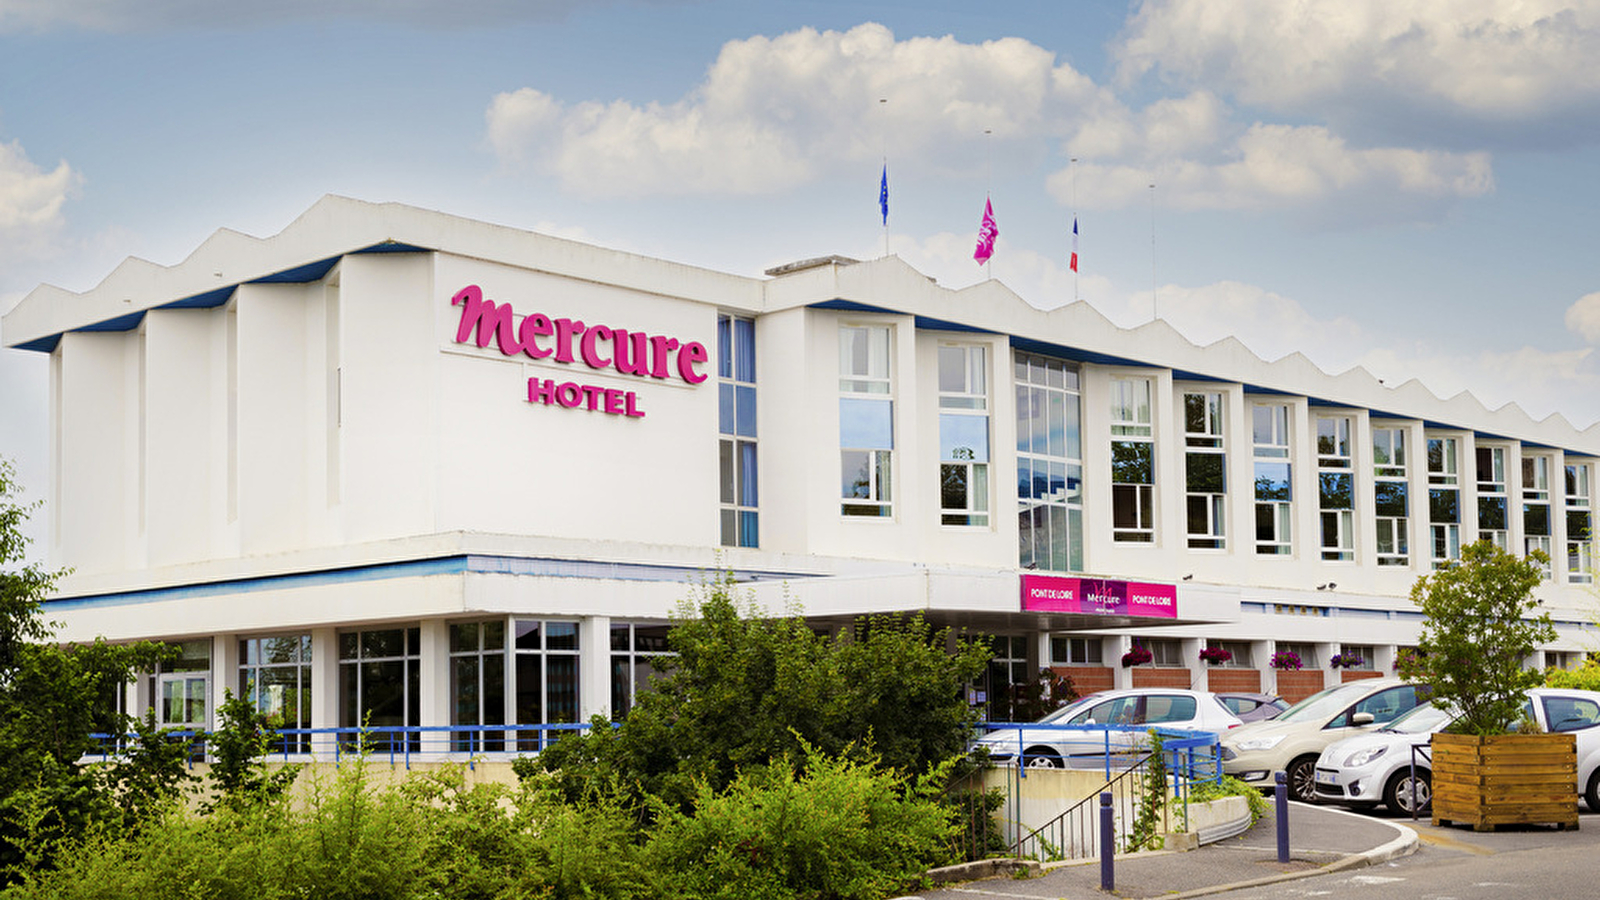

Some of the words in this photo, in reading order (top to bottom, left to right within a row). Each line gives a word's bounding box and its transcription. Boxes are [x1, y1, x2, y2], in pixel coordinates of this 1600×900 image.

[527, 377, 645, 418] HOTEL
[1031, 588, 1047, 598] PONT
[1087, 593, 1120, 604] Mercure
